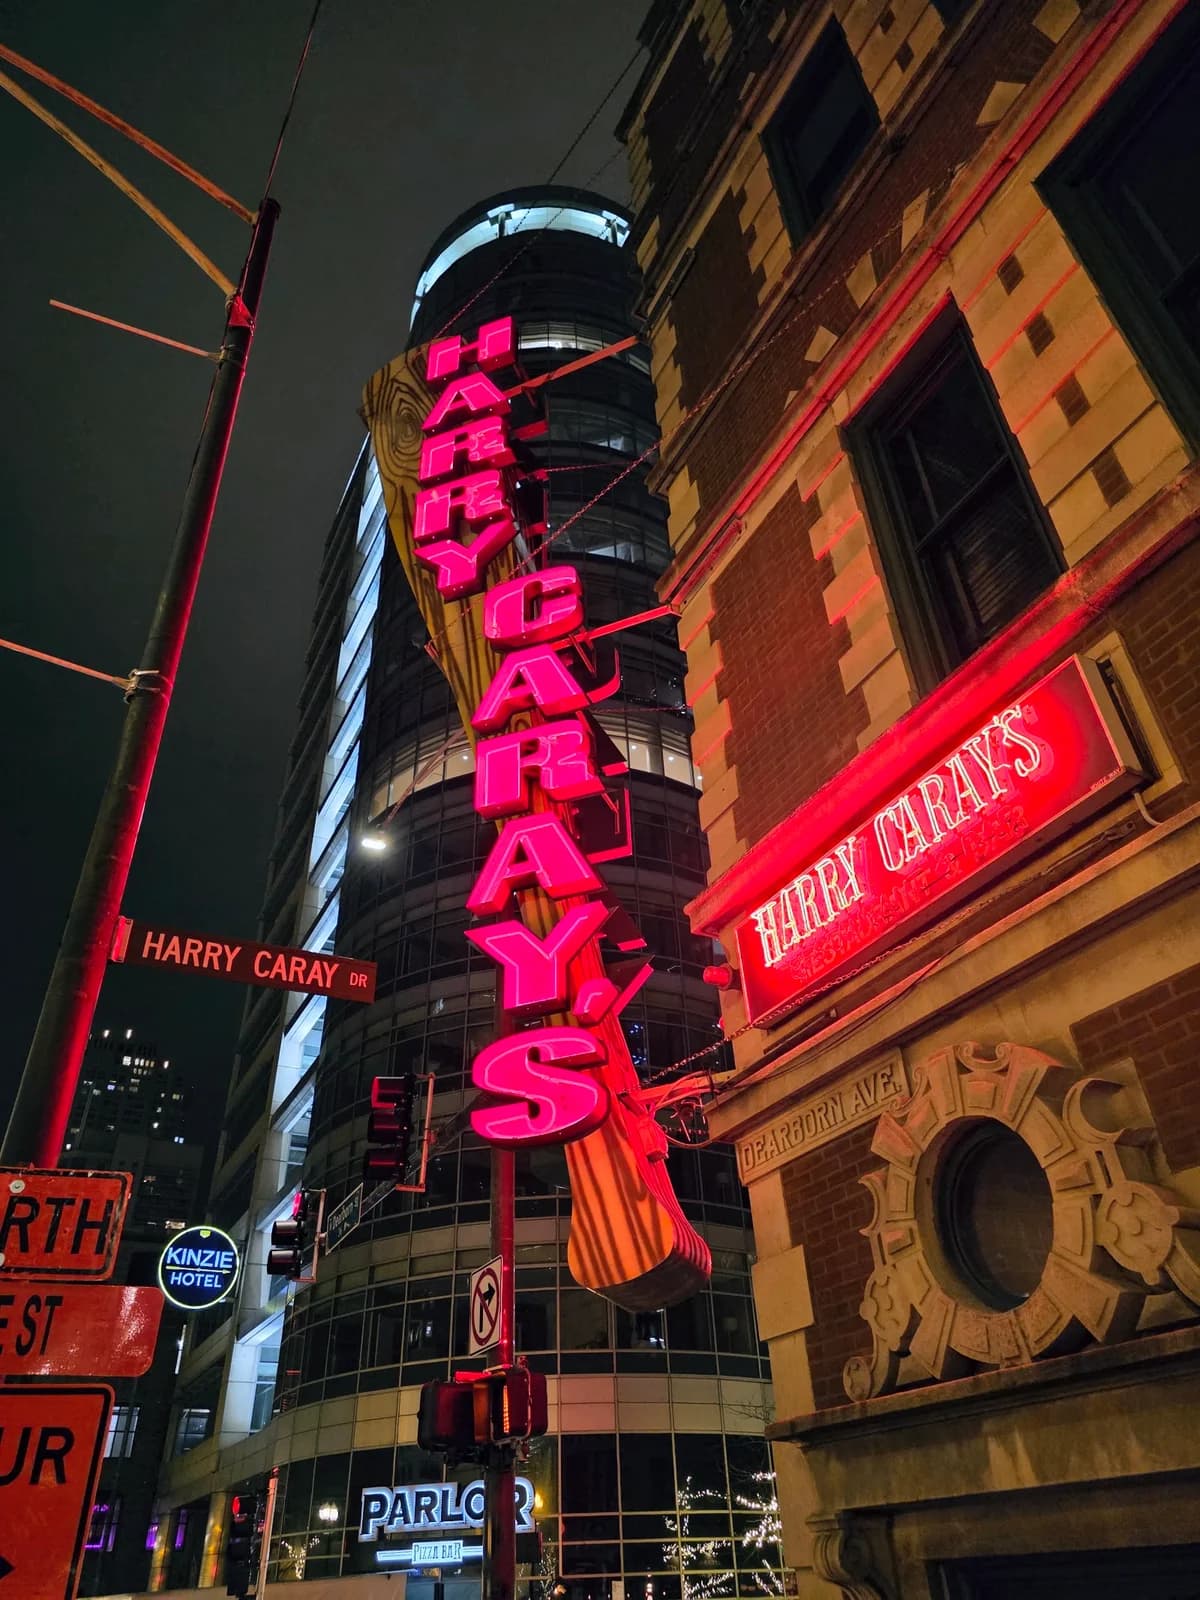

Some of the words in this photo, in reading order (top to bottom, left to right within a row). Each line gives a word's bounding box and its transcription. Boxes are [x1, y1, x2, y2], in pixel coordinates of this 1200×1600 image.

[413, 316, 517, 603] HARRY
[751, 836, 866, 967] HARRY
[142, 931, 242, 972] HARRY
[254, 950, 339, 988] CARAY
[350, 972, 368, 988] DR
[742, 1091, 847, 1171] DEARBORN
[166, 1247, 234, 1268] KINZIE
[170, 1272, 222, 1288] HOTEL
[359, 1478, 534, 1540] PARLOR
[441, 1543, 462, 1560] BAR
